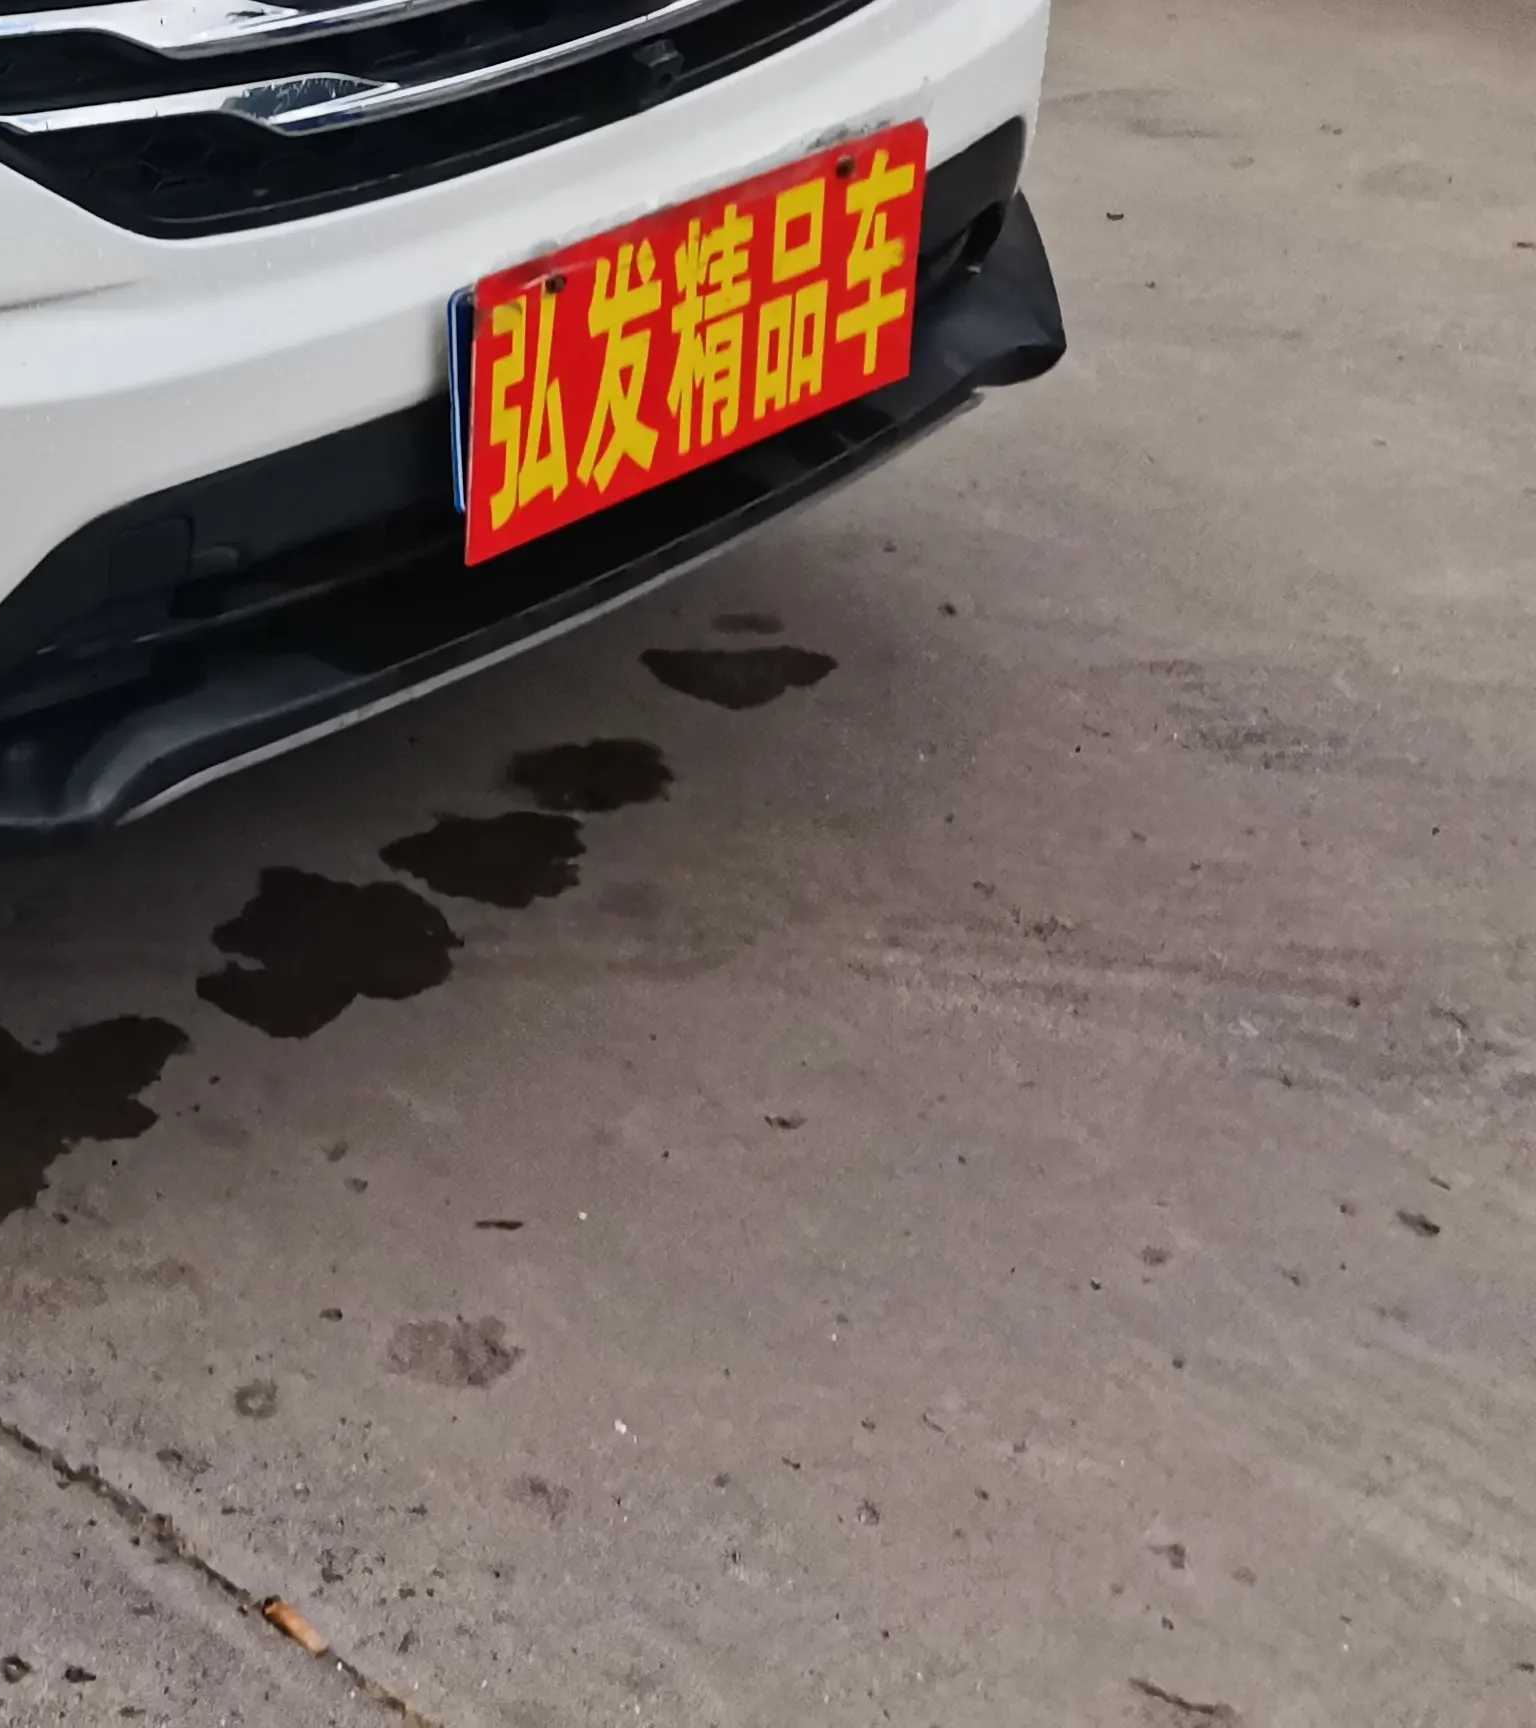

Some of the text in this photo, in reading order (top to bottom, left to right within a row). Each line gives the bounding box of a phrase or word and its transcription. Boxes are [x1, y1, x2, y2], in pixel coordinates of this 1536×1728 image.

[490, 150, 915, 531] 弘发精品车
